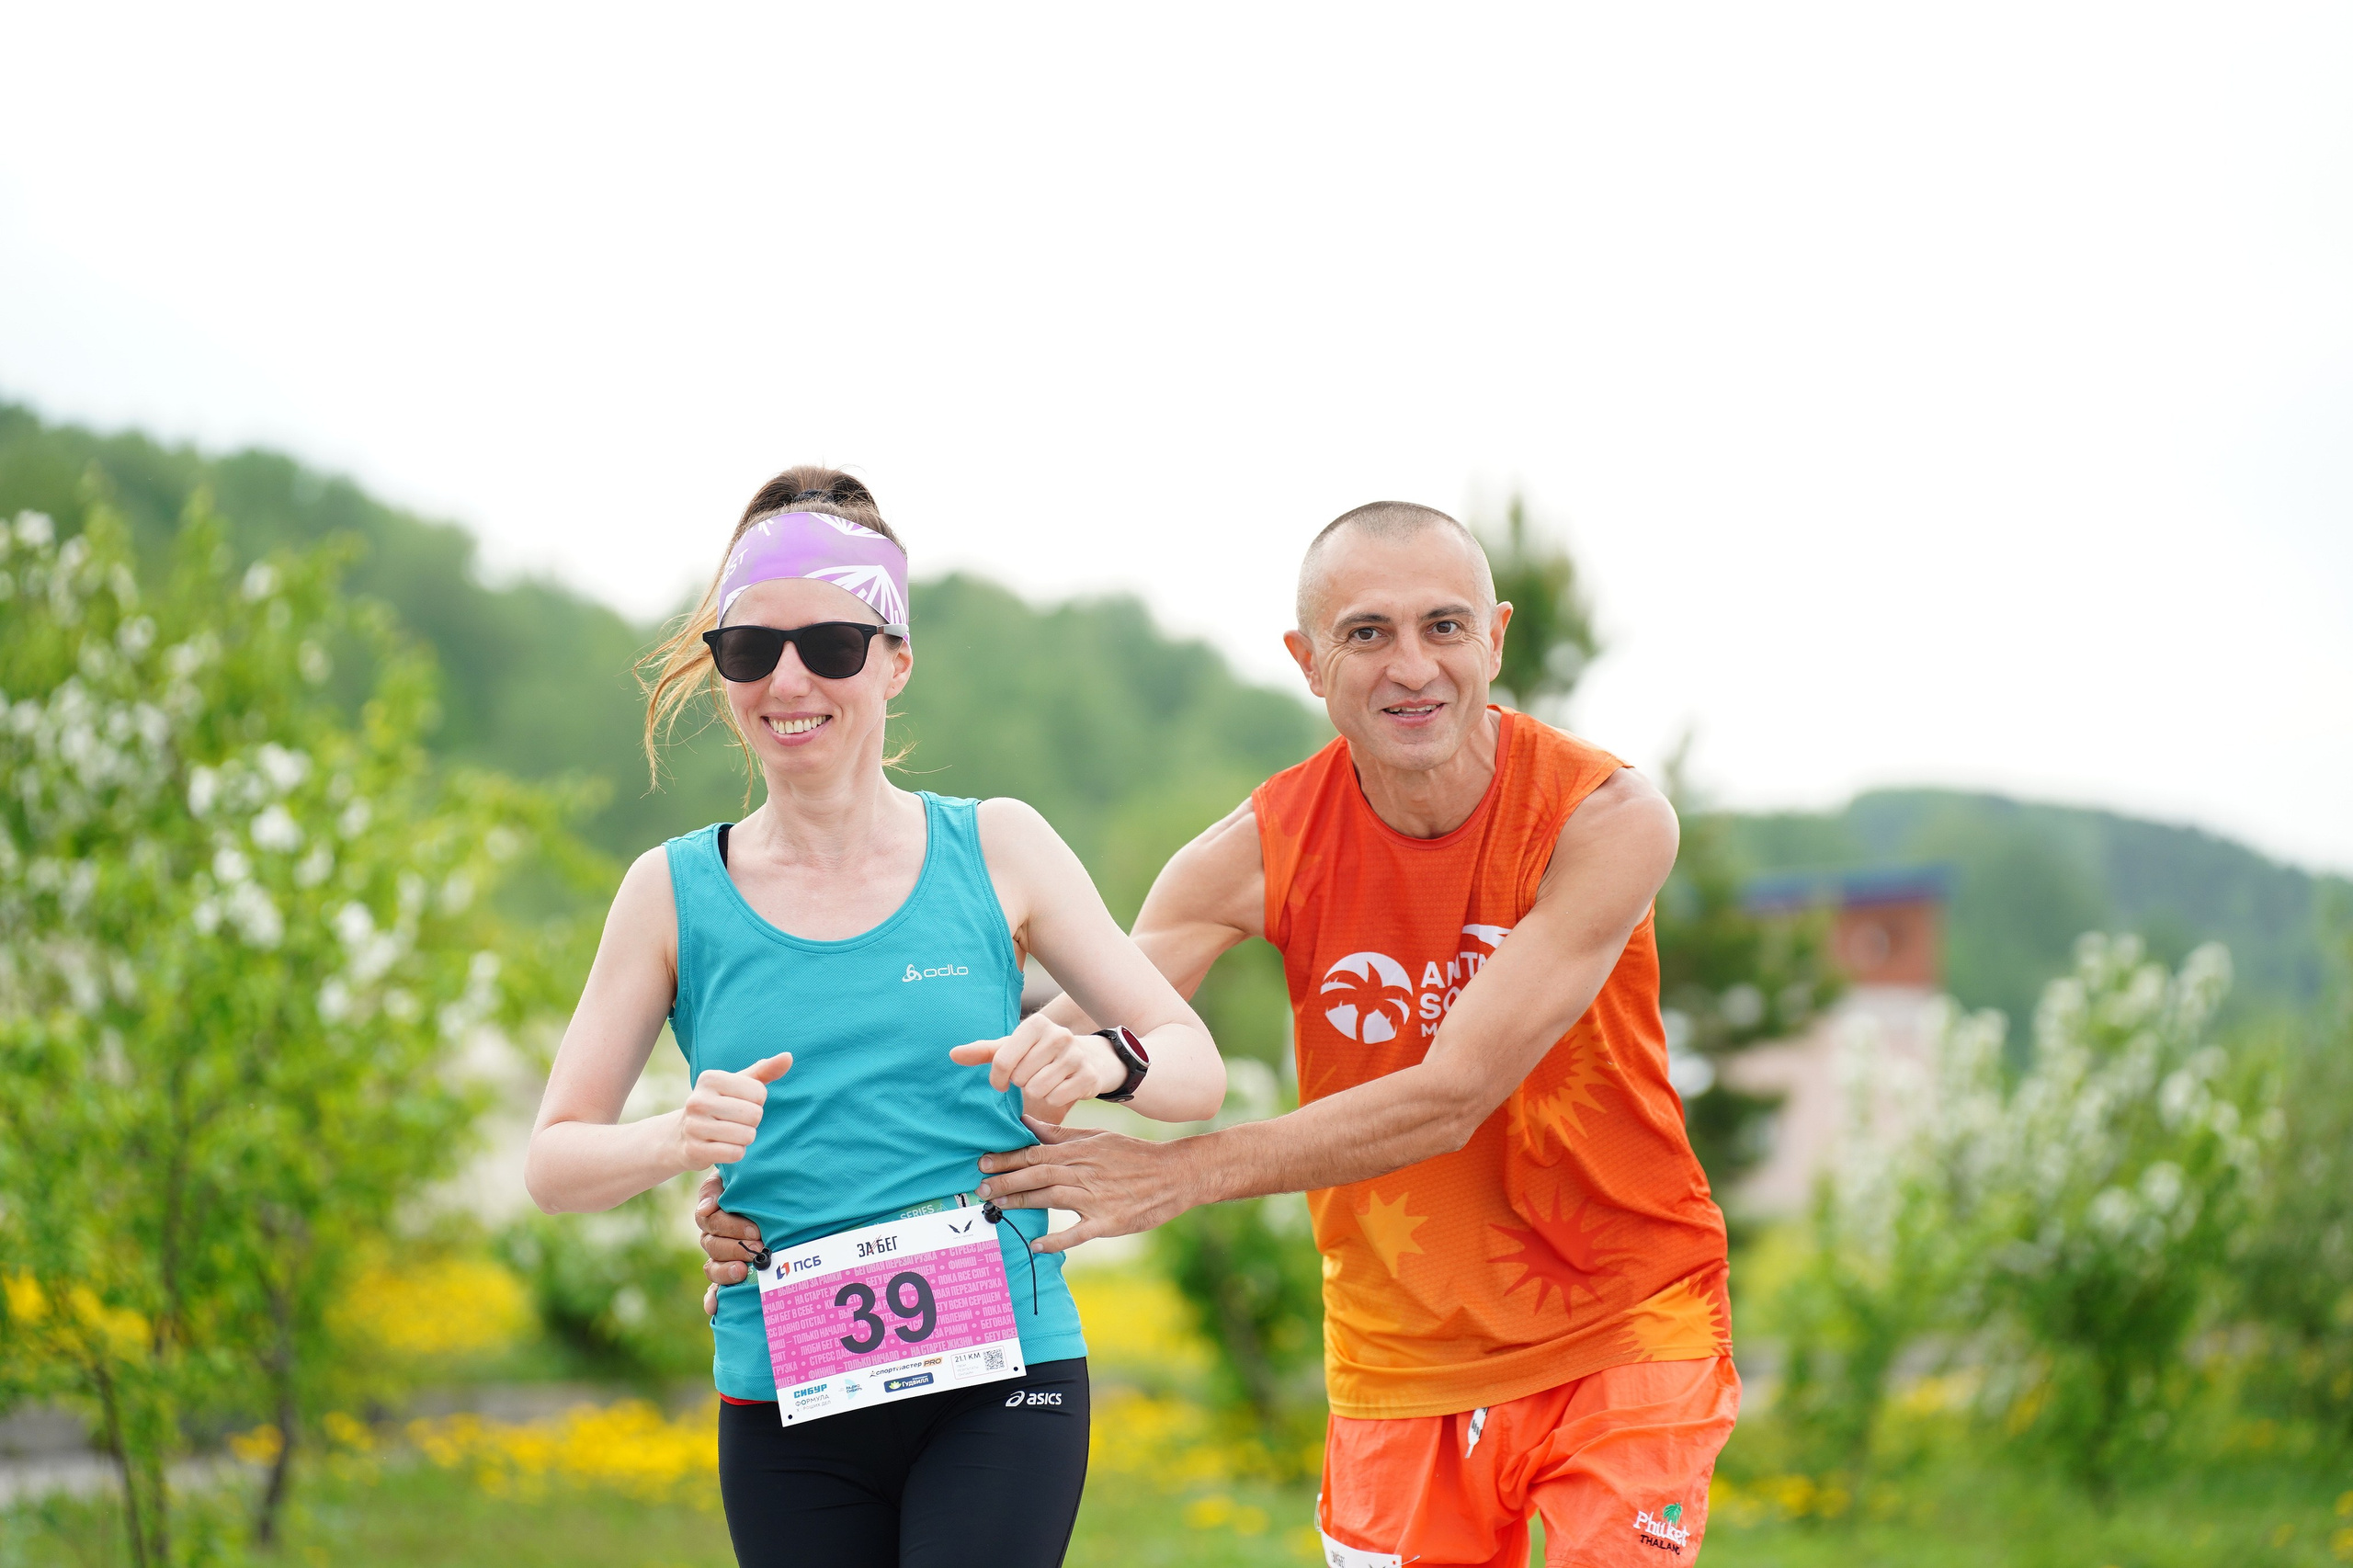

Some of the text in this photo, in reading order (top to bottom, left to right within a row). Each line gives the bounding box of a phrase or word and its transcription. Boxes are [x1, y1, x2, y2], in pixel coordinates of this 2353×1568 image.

[924, 964, 969, 977] odlo
[900, 1204, 935, 1220] SERIES
[949, 1244, 976, 1256] СТРЕСС
[793, 1255, 822, 1272] ПСБ
[854, 1250, 938, 1277] БЕГОВАЯ ПЕРЕЗАГРУЗКА
[948, 1256, 977, 1270] ФИНИШ
[818, 1271, 842, 1285] РАМКИ
[865, 1275, 882, 1287] БЕГУ
[938, 1267, 990, 1285] ПОКА ВСЕ СПЯТ
[950, 1278, 1002, 1295] ПЕРЕЗАГРУЗКА
[794, 1294, 804, 1305] НА
[803, 1288, 828, 1302] СТАРТЕ
[948, 1297, 968, 1310] ВСЕМ
[968, 1290, 1001, 1306] СЕРДЦЕМ
[779, 1310, 791, 1322] БЕГ
[791, 1308, 797, 1318] В
[797, 1303, 814, 1316] СЕБЕ
[834, 1272, 938, 1355] 39
[982, 1304, 1002, 1316] ПОКА
[778, 1321, 800, 1336] ДАВНО
[800, 1314, 825, 1329] ОТСТАЛ
[944, 1323, 968, 1335] РАМКИ
[980, 1314, 1011, 1329] БЕГОВАЯ
[792, 1329, 820, 1345] ТОЛЬКО
[819, 1323, 847, 1338] НАЧАЛО
[983, 1330, 1001, 1342] БЕГУ
[800, 1342, 821, 1356] ЛЮБИ
[821, 1338, 834, 1350] БЕГ
[834, 1337, 839, 1346] В
[910, 1346, 921, 1357] НА
[920, 1340, 947, 1354] СТАРТЕ
[946, 1335, 972, 1348] ЖИЗНИ
[808, 1350, 900, 1380] ФИНИШ ТОЛЬКО НАЧАЛО
[809, 1351, 835, 1366] СТРЕСС
[923, 1358, 942, 1366] PRO
[793, 1383, 827, 1398] СИБУР
[1026, 1392, 1063, 1405] asics
[795, 1393, 829, 1406] ФОРМУЛА
[1632, 1510, 1691, 1548] Phuket
